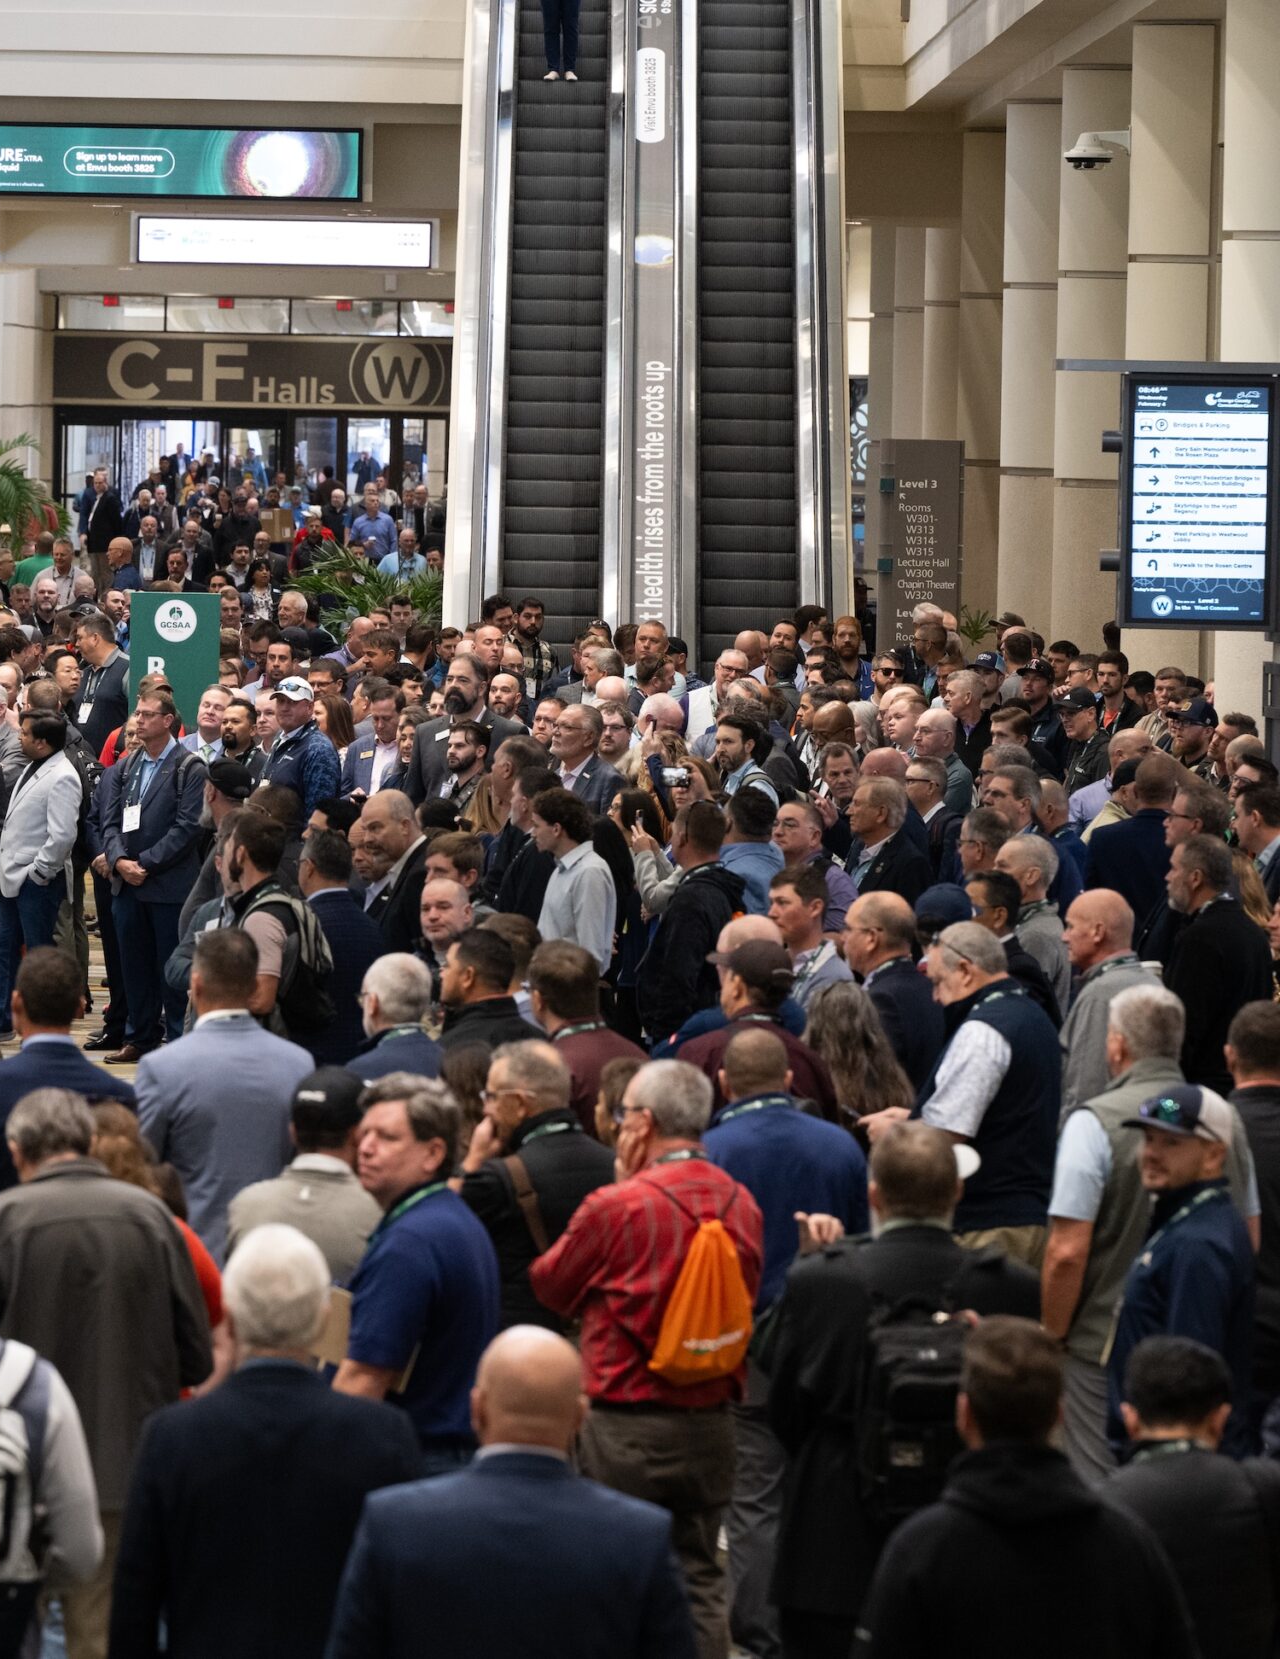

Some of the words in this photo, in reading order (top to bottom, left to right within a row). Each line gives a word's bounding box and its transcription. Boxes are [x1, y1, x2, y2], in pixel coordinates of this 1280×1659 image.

[644, 58, 656, 75] 3825
[644, 76, 656, 97] booth
[644, 98, 656, 115] Envu
[644, 117, 656, 132] Visit
[76, 152, 94, 162] Sign
[96, 154, 107, 162] up
[108, 153, 117, 161] to
[118, 152, 140, 162] learn
[141, 154, 163, 162] more
[75, 164, 86, 172] at
[108, 164, 133, 172] booth
[646, 360, 671, 381] up
[372, 356, 422, 399] W
[253, 376, 335, 405] Halls
[641, 384, 665, 429] roots
[637, 432, 664, 461] the
[636, 464, 664, 503] from
[899, 480, 927, 488] Level
[931, 480, 938, 488] 3
[899, 503, 931, 512] Rooms
[907, 514, 938, 523] W301-
[636, 506, 664, 548] rises
[906, 525, 934, 534] W313
[906, 536, 938, 545] W314-
[906, 547, 934, 556] W315
[897, 559, 930, 567] Lecture
[932, 558, 950, 567] Hall
[905, 569, 934, 578] W300
[636, 552, 664, 609] health
[897, 580, 925, 591] Chapin
[926, 580, 955, 589] Theater
[904, 591, 933, 600] W320
[1156, 601, 1169, 611] W
[896, 609, 914, 617] Lev
[160, 621, 191, 629] GCSAA
[895, 632, 915, 641] Roo
